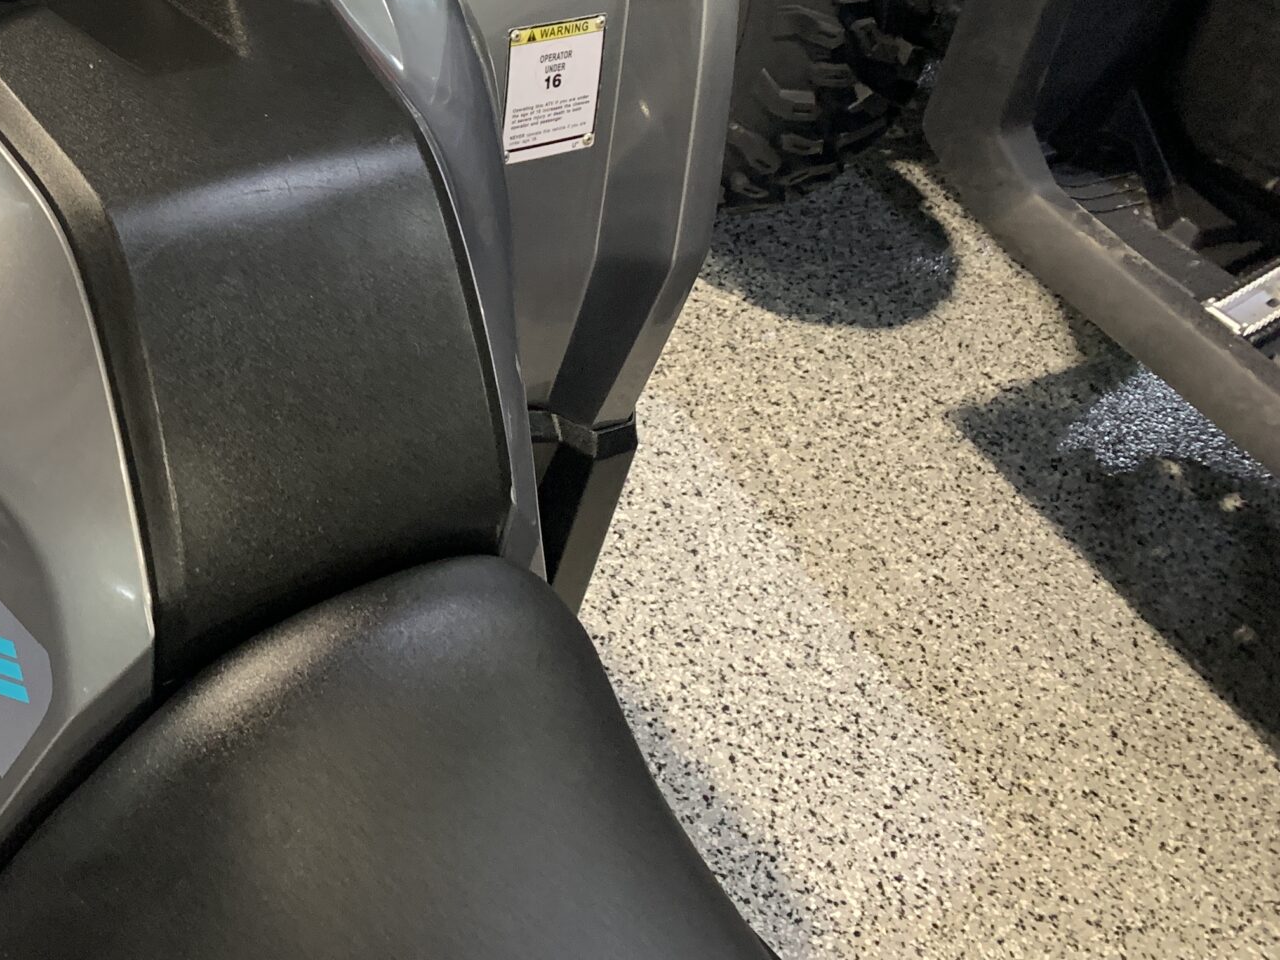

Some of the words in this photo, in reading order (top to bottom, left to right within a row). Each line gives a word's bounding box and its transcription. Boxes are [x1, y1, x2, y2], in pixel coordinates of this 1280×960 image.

[540, 22, 589, 38] WARNING
[540, 50, 572, 63] OPERATOR
[545, 63, 565, 74] UNDER
[545, 74, 562, 89] 16
